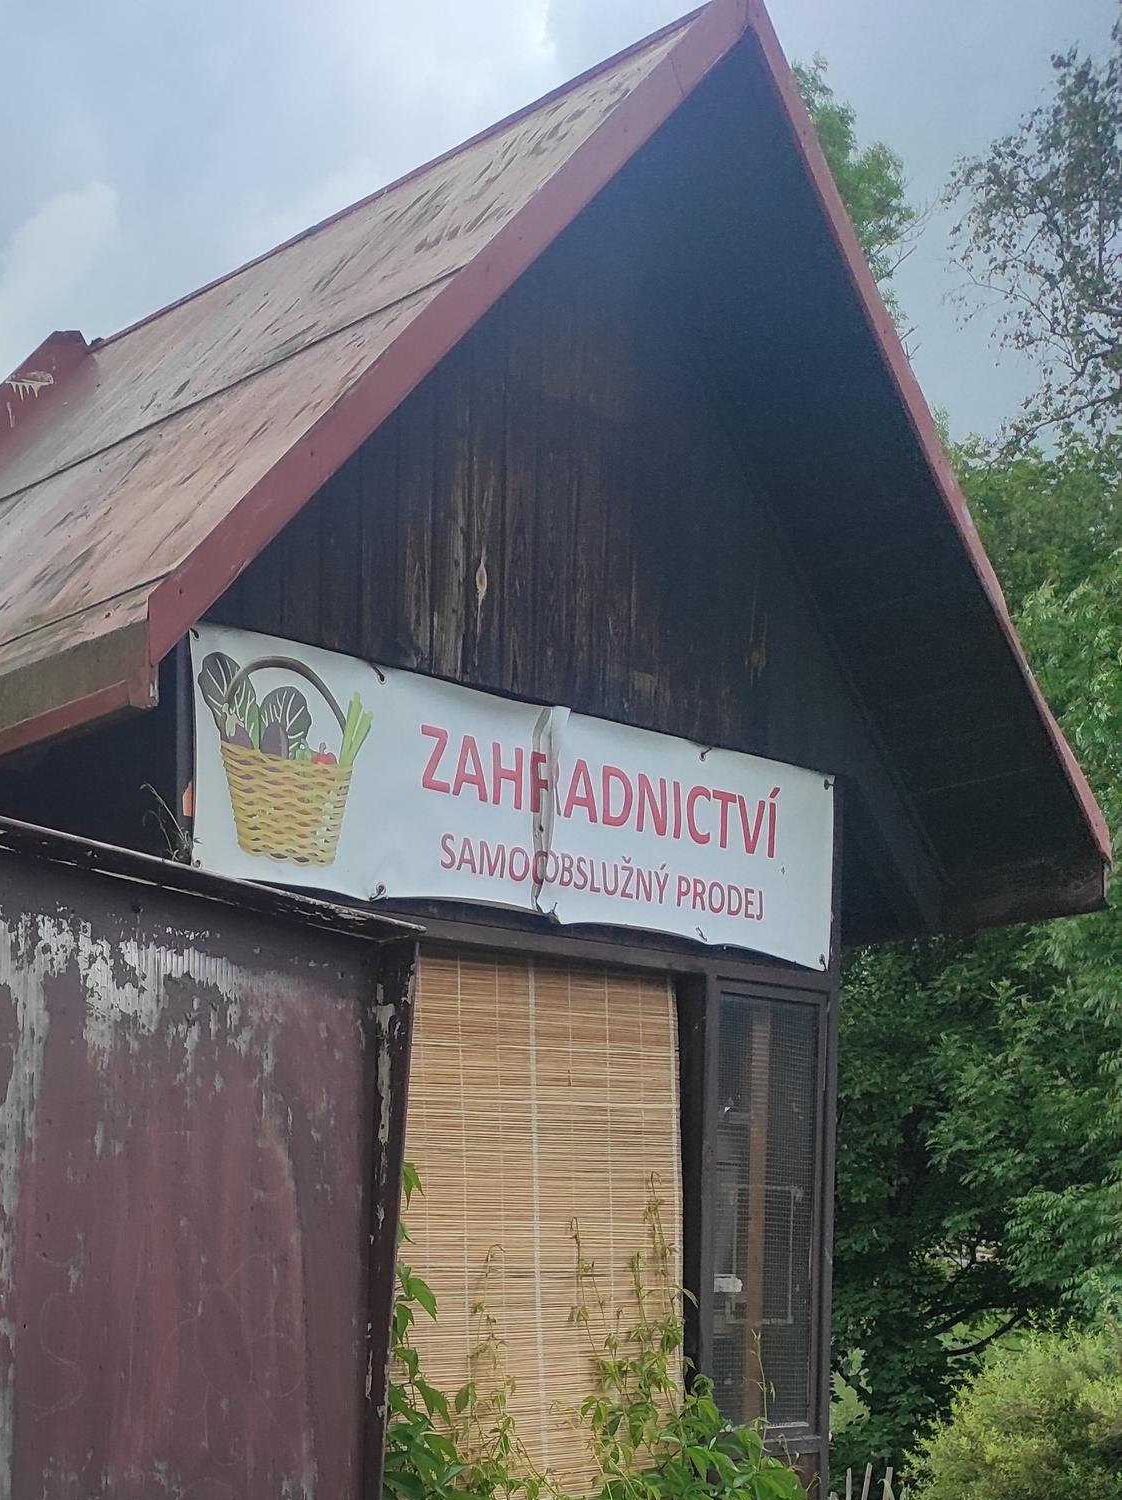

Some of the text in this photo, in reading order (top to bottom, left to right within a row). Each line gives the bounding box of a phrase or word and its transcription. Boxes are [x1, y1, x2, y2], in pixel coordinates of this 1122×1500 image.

[420, 723, 780, 858] ZAHRADNICTVÍ
[440, 833, 765, 921] SAMOOBSLUŽNÝ PRODEJ
